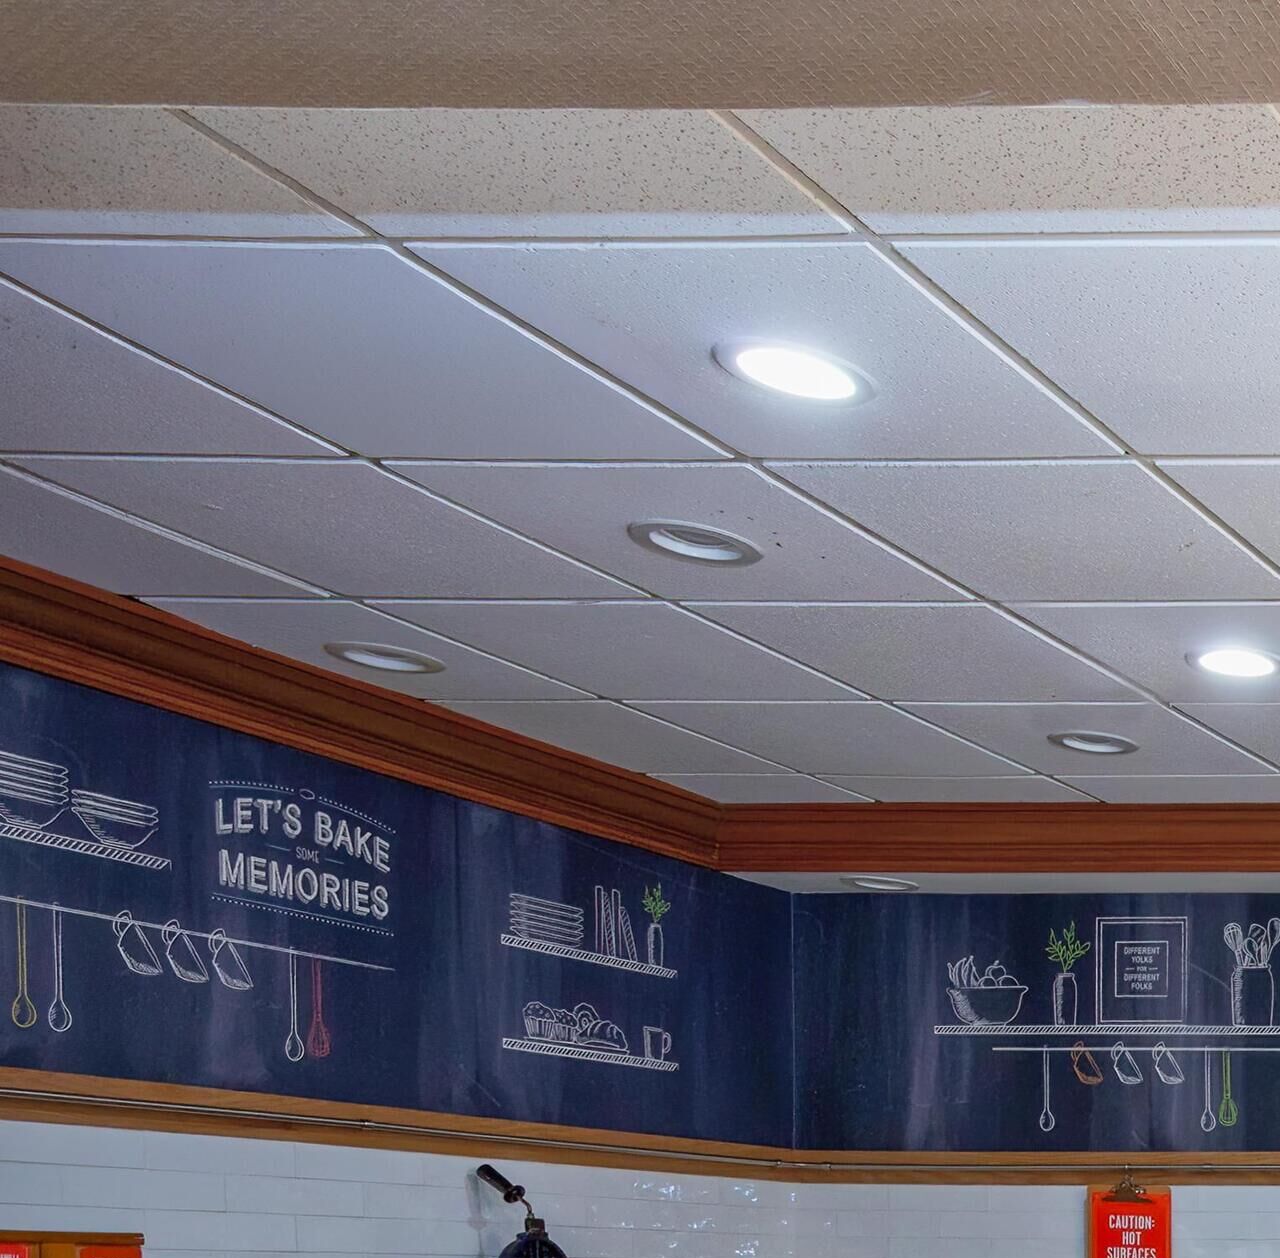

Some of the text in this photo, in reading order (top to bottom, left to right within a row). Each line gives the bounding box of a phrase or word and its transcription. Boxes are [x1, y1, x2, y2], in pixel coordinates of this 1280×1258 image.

[215, 797, 391, 874] LET'S BAKE
[295, 846, 320, 864] SOME
[218, 848, 390, 921] MEMORIES
[1123, 946, 1160, 955] DIFFERENT
[1131, 956, 1153, 964] YOLKS
[1123, 973, 1160, 982] DIFFERENT
[1131, 982, 1153, 990] FOLKS
[1108, 1214, 1156, 1230] CAUTION:
[1122, 1231, 1142, 1246] HOT
